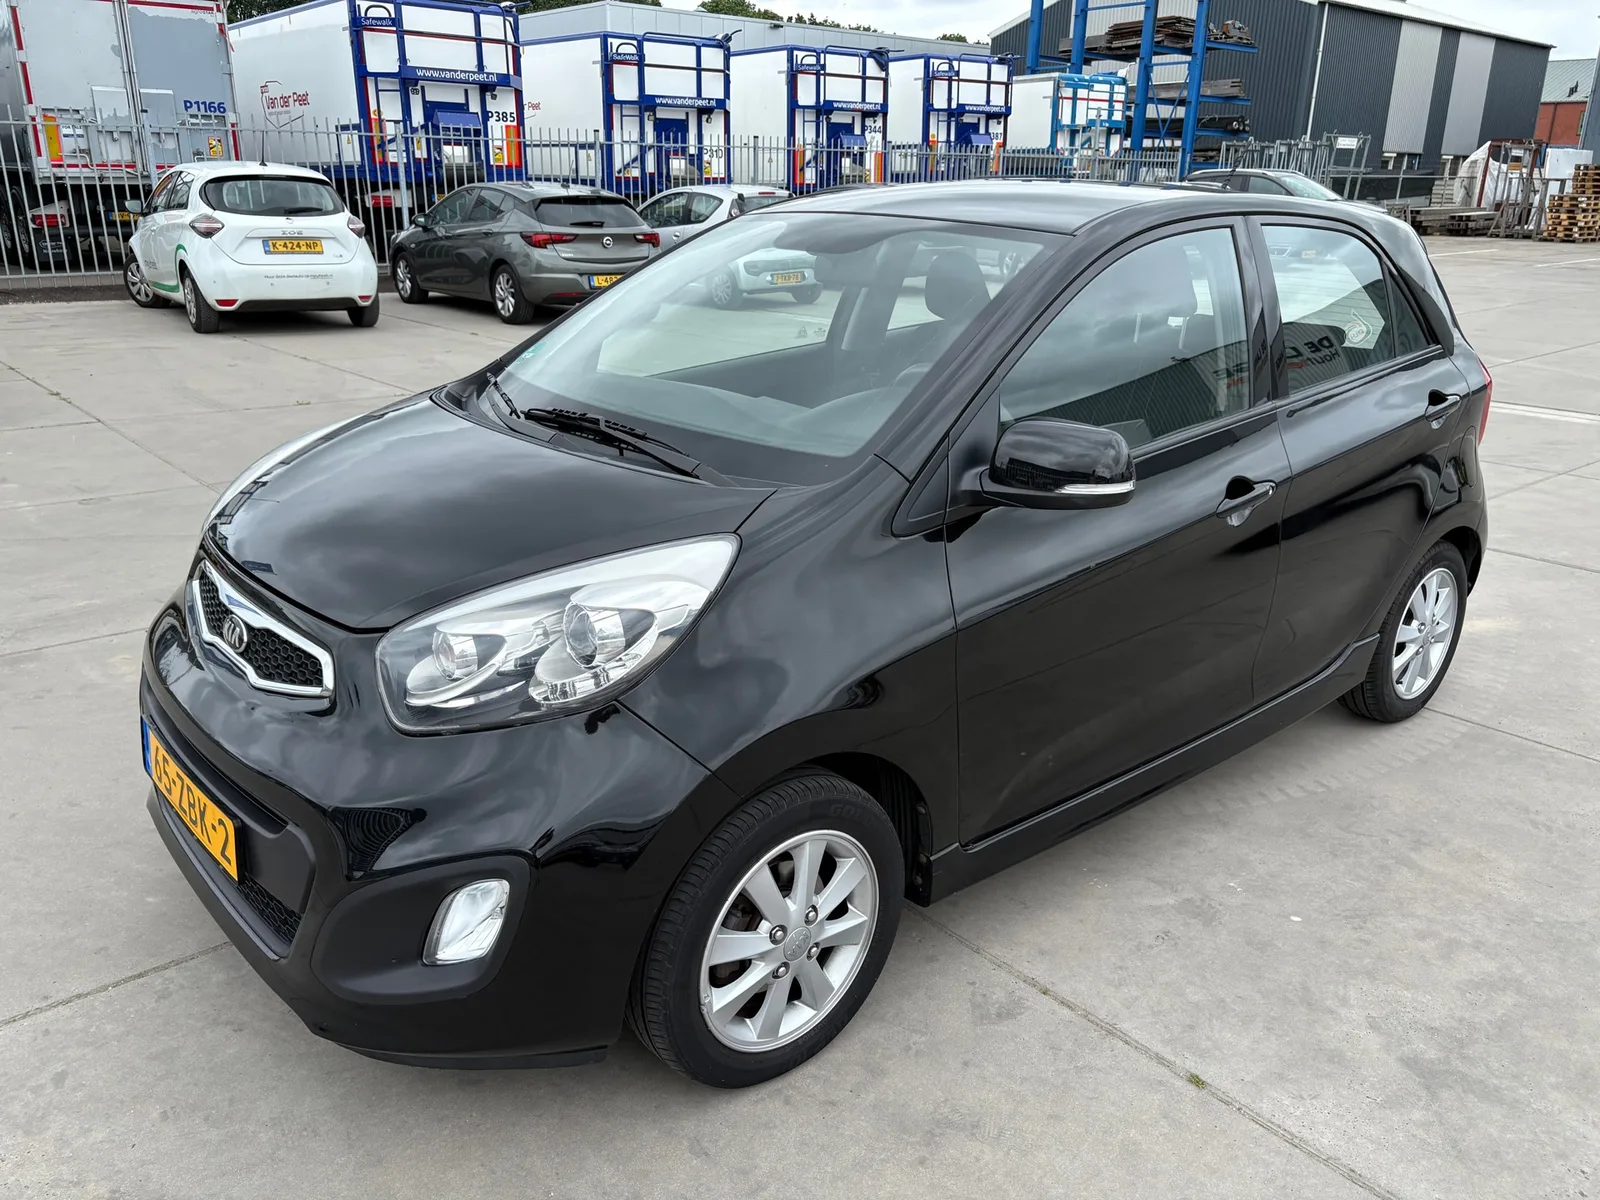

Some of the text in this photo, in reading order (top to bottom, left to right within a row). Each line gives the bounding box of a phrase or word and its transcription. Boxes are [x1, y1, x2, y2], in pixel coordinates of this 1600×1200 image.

[361, 18, 393, 26] Safewalk
[416, 69, 498, 82] www.vanderpeet.nl
[264, 90, 310, 110] Van der Peet
[655, 97, 717, 107] www.vanderpeet.nl
[183, 99, 227, 114] P1166
[832, 102, 881, 110] www.vanderpeet.nl
[965, 105, 1006, 113] www.vanderpeet.nl
[487, 110, 516, 123] P385
[271, 241, 319, 251] K-424-NP
[153, 744, 233, 867] 65-ZBK-2
